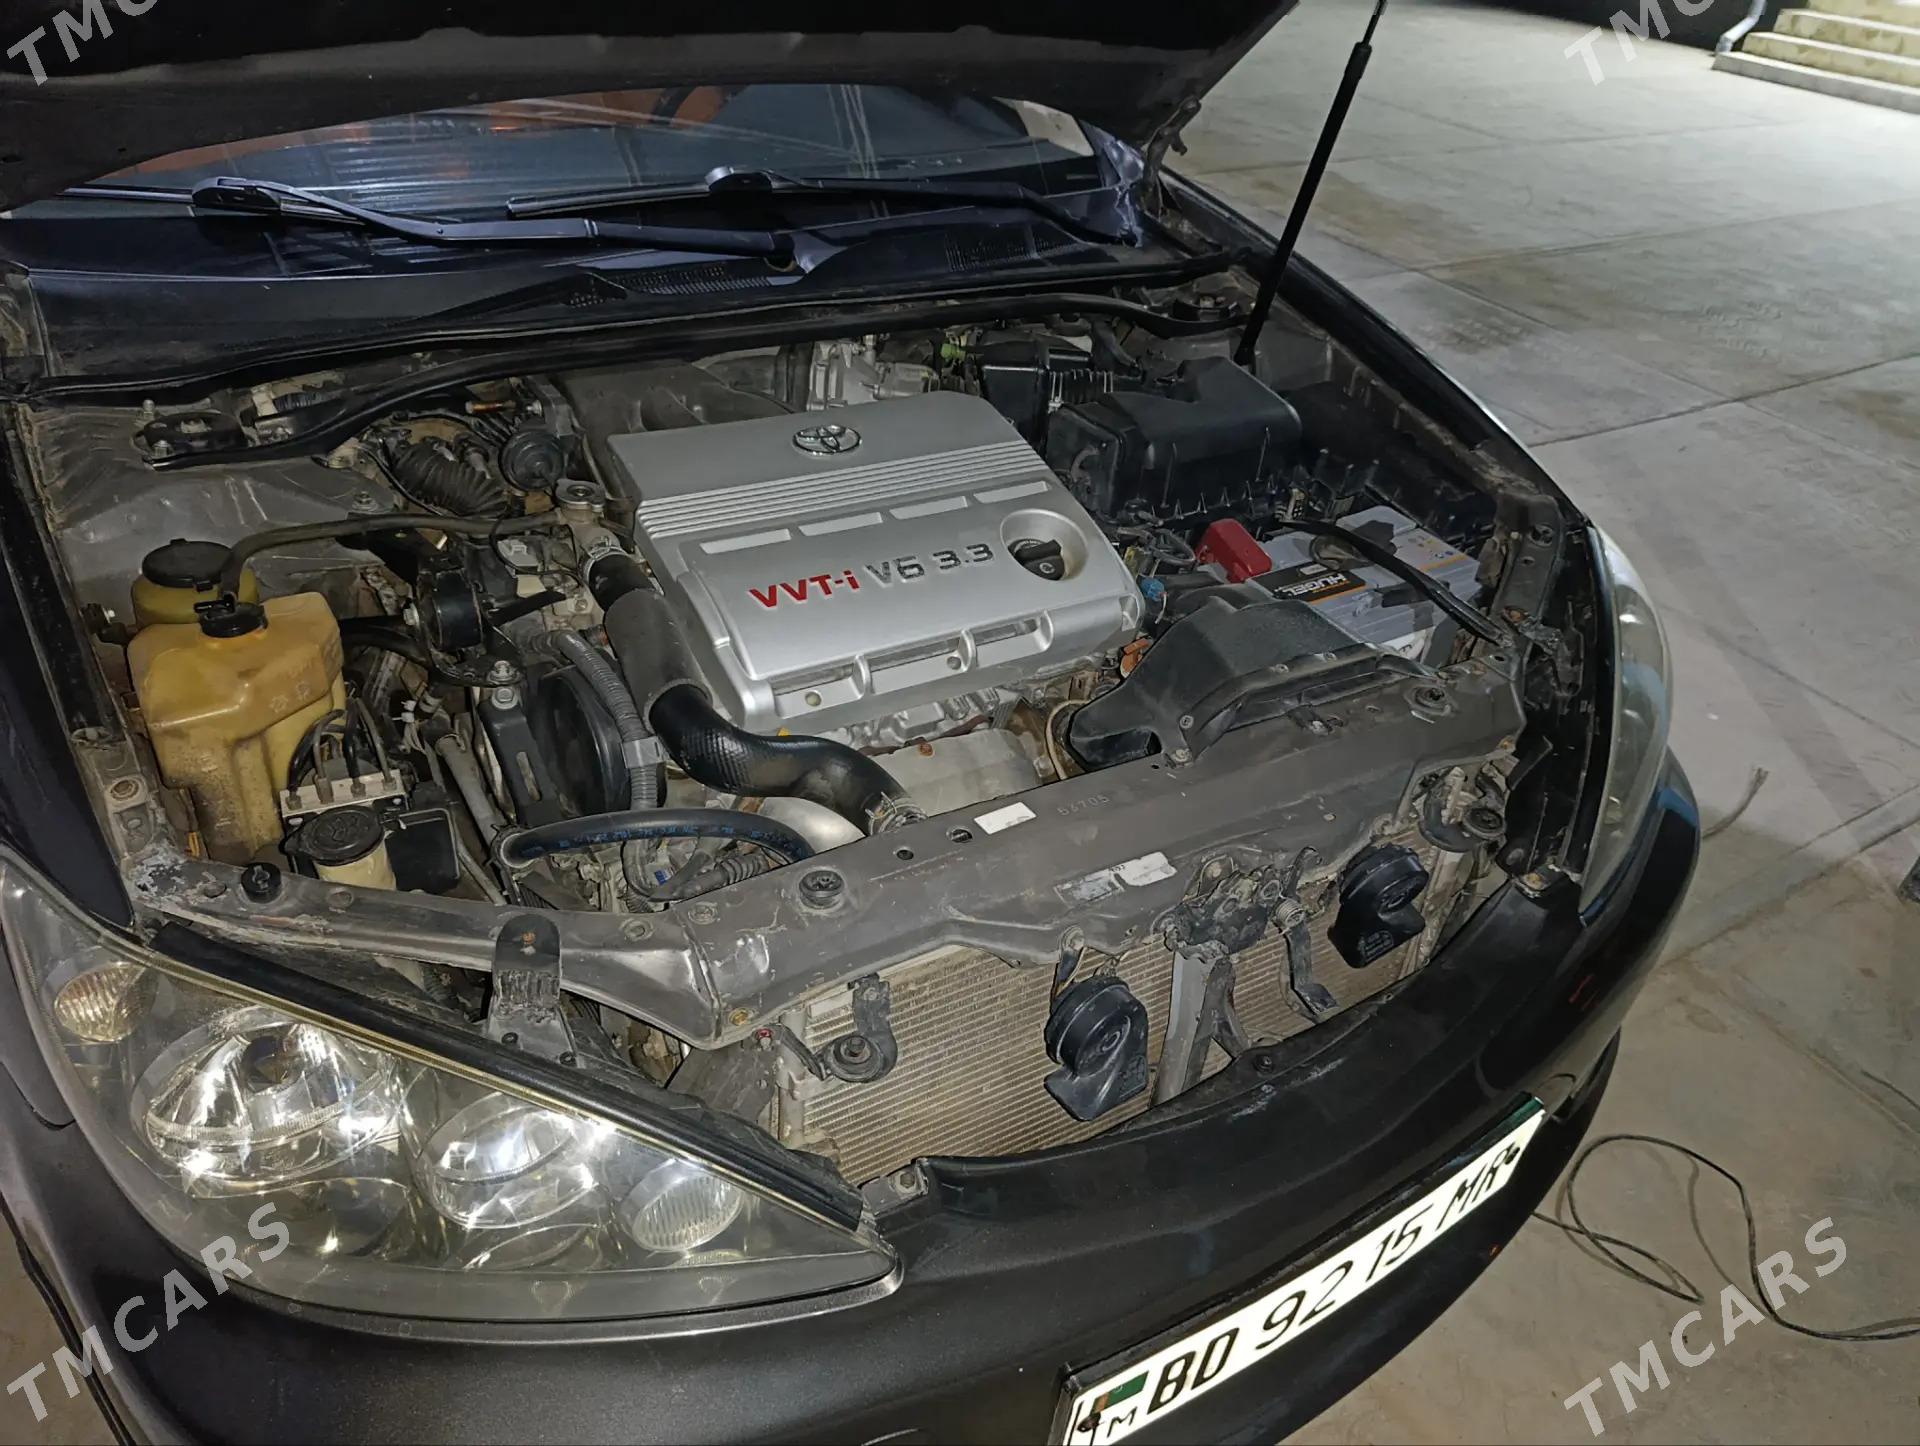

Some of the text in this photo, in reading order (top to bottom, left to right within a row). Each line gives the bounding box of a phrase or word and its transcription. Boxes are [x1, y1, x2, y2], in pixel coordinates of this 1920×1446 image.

[749, 543, 994, 609] VVT-i V6 3.3
